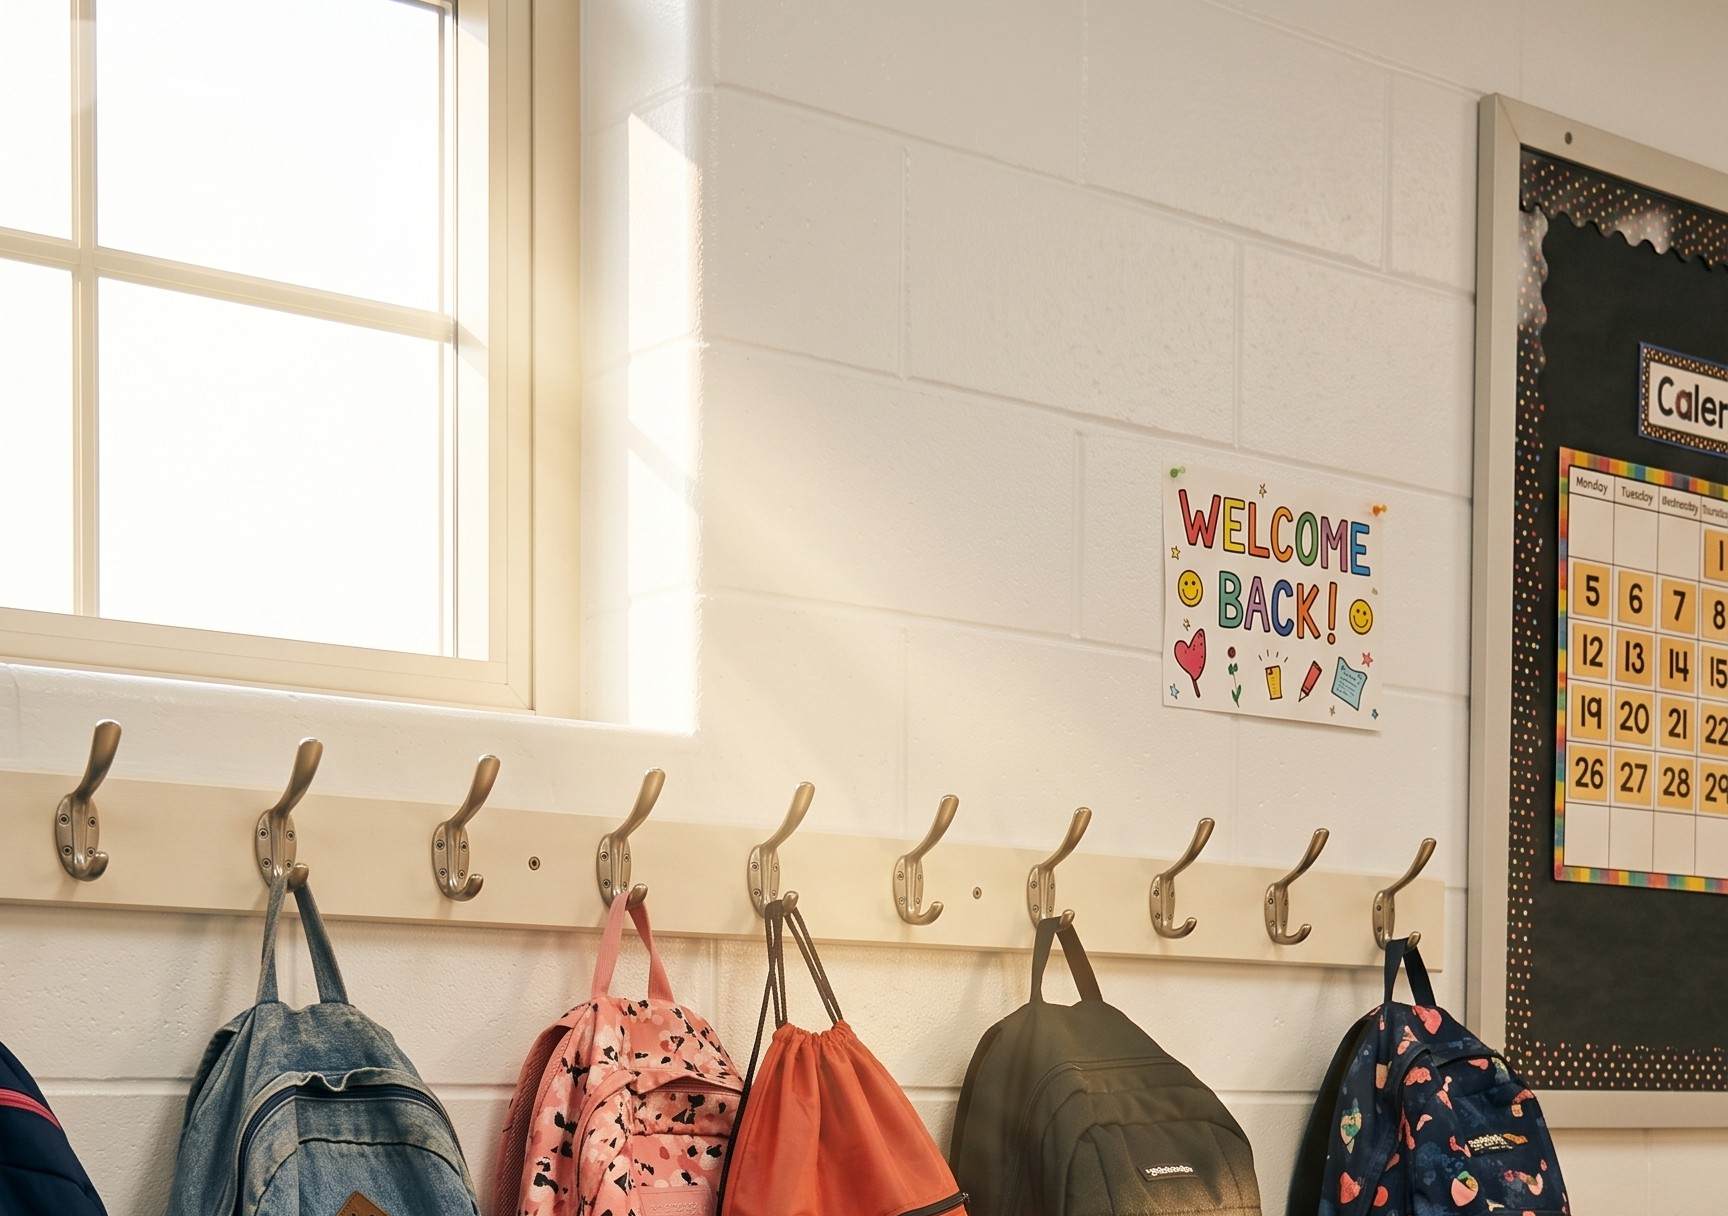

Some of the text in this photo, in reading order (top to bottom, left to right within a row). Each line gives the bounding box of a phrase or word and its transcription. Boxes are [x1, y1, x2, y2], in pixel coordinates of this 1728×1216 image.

[1575, 476, 1608, 496] Monday
[1620, 486, 1653, 506] Tuesday
[1178, 488, 1371, 577] WELCOME
[1719, 539, 1724, 571] 1
[1218, 570, 1338, 645] BACK!
[1585, 574, 1726, 630] 5 6 7 8
[1582, 634, 1728, 689] 12 13 14 15
[1581, 695, 1728, 746] 19 20 21 22
[1575, 757, 1604, 789] 26
[1620, 762, 1648, 794] 27
[1663, 767, 1691, 798] 28
